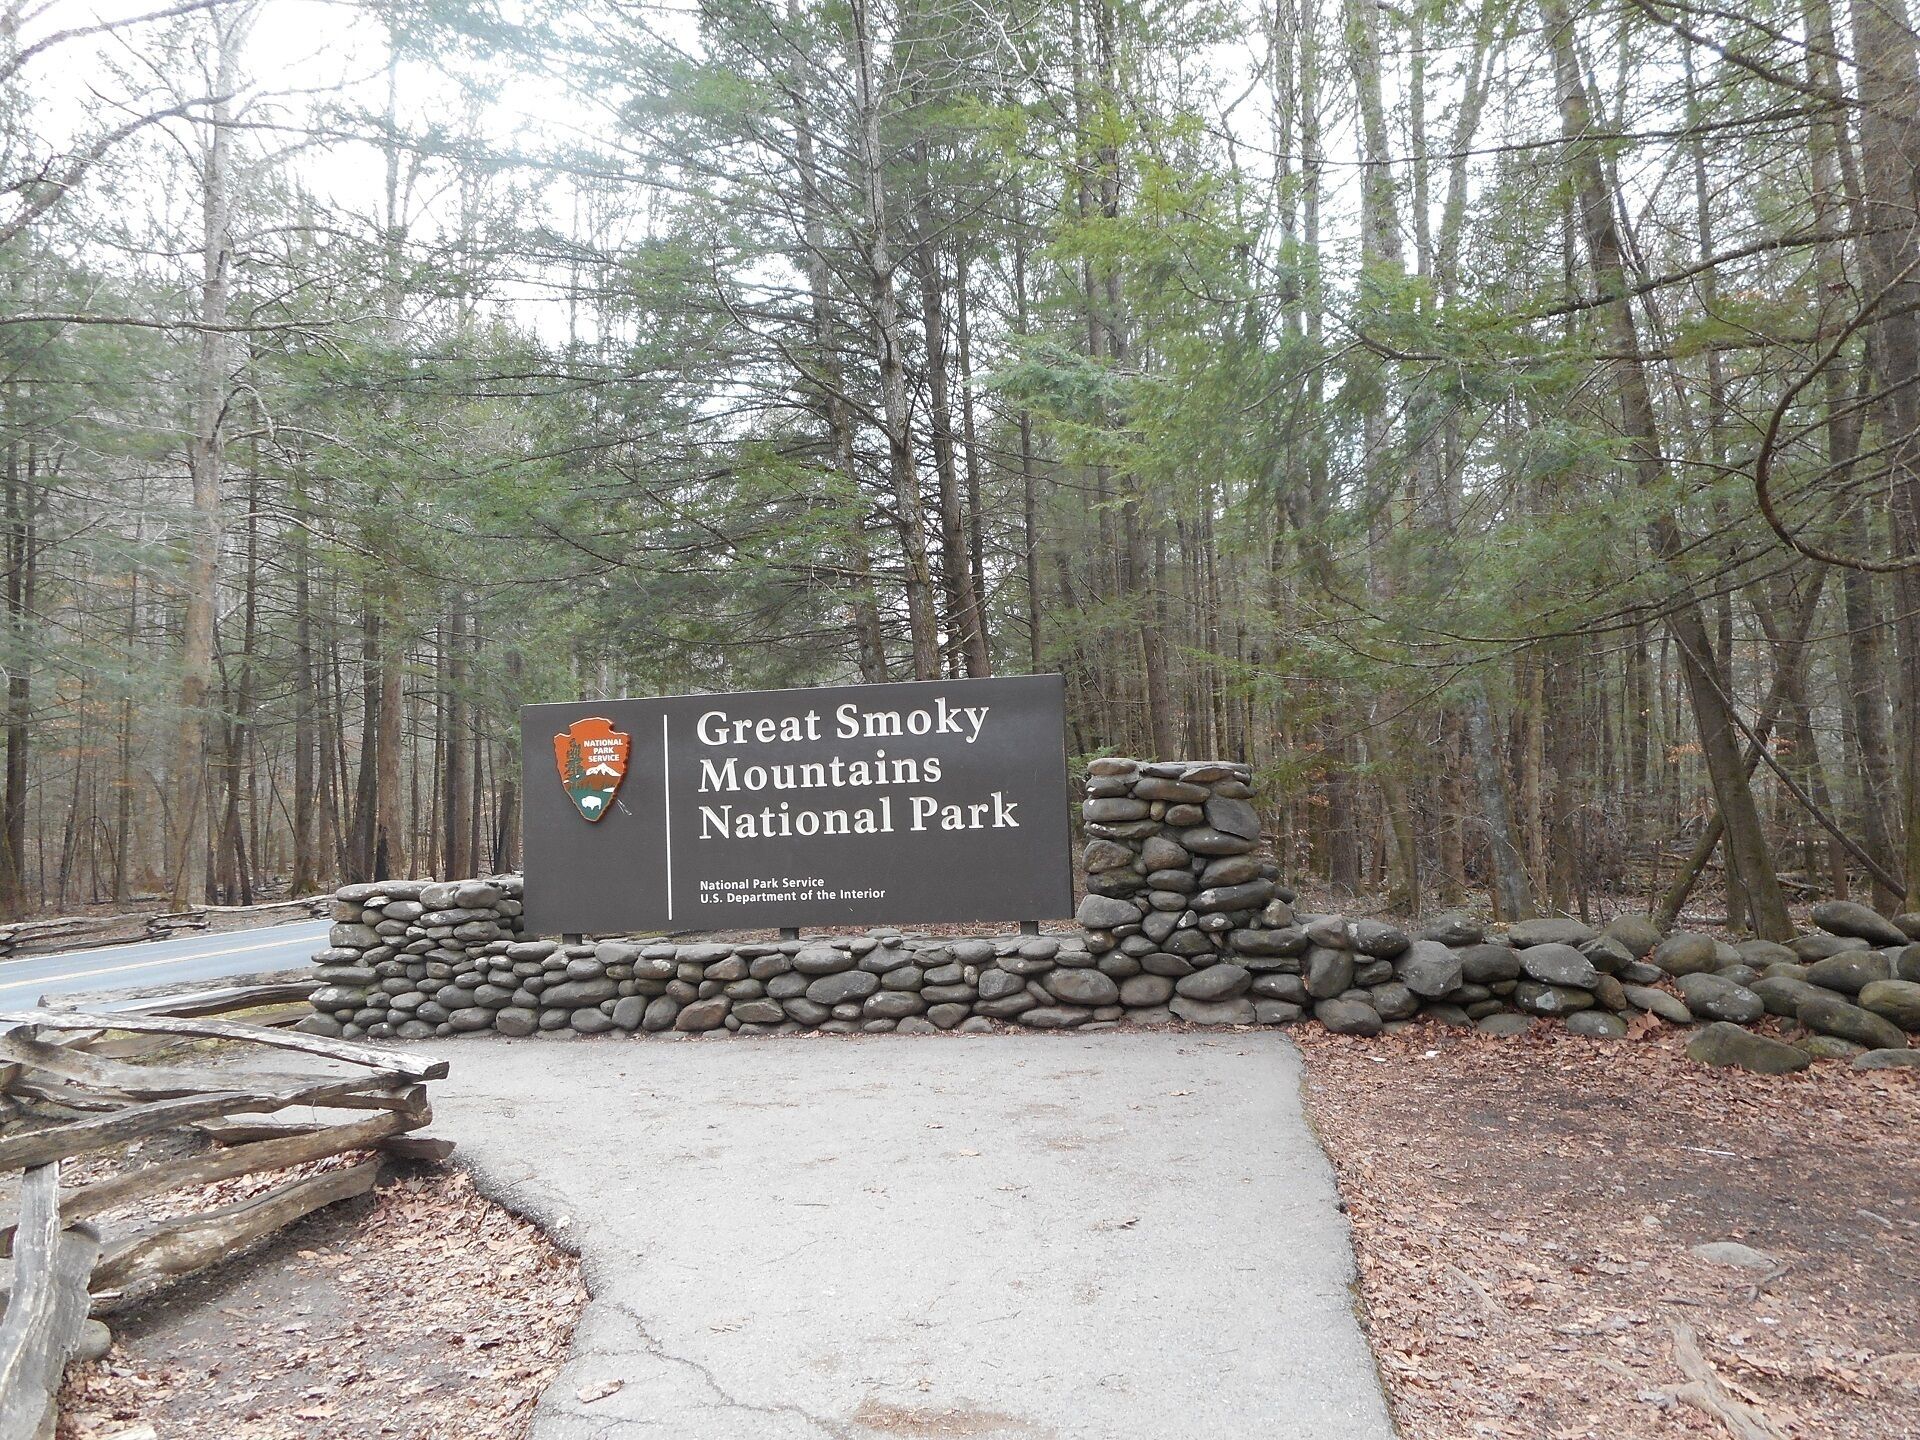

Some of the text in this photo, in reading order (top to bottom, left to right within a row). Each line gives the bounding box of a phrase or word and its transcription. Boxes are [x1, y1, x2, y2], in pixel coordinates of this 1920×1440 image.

[697, 697, 989, 745] Great Smoky
[583, 738, 623, 747] NATIONAL
[587, 754, 620, 763] SERVICE
[698, 749, 941, 792] Mountains
[699, 792, 1019, 839] National Park
[701, 877, 824, 890] National Park Service
[701, 888, 885, 904] U.S. Department of the Interior
